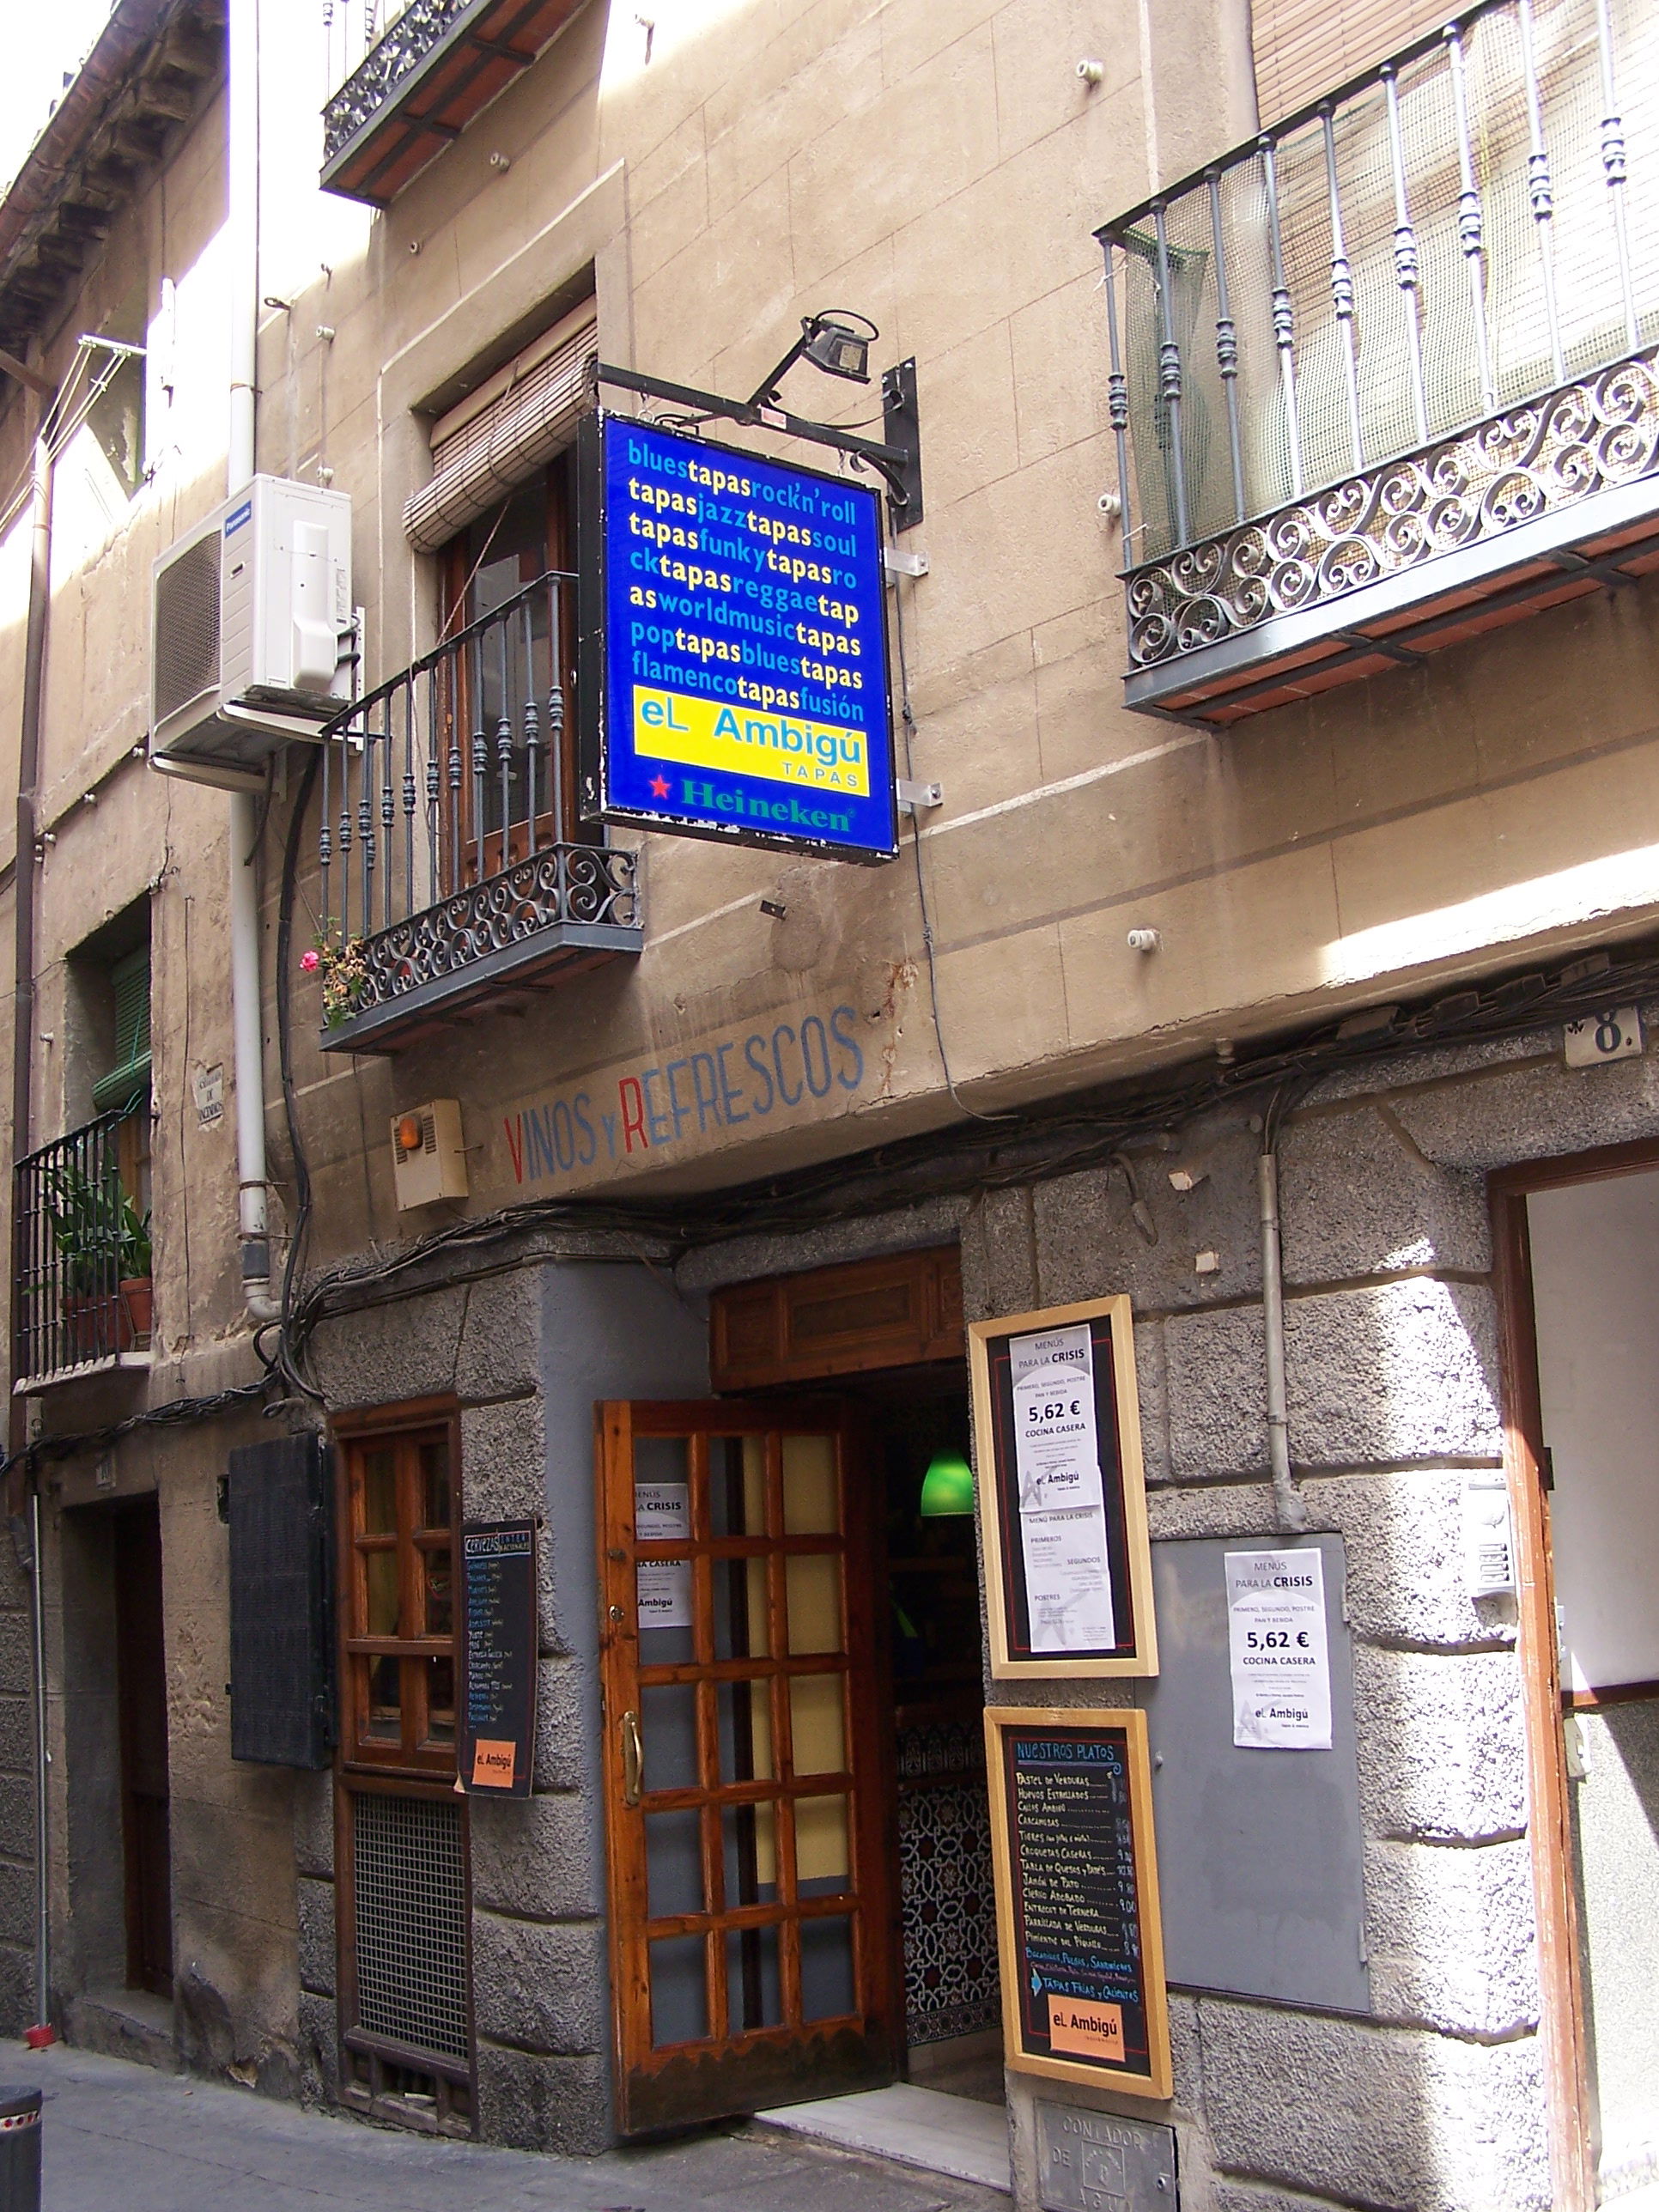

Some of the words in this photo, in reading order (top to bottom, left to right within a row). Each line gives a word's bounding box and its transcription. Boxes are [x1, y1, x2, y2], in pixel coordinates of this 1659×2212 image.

[714, 708, 860, 767] Ambigú
[782, 762, 857, 787] TAPAS
[681, 779, 853, 833] Heineken
[504, 1092, 597, 1184] VINOS
[617, 1006, 865, 1153] REFRESCOS
[1035, 1337, 1065, 1351] MENÚS
[1018, 1358, 1039, 1369] PARA
[1040, 1357, 1050, 1365] LA
[1051, 1348, 1085, 1363] CRISIS
[1029, 1403, 1065, 1424] 5,62
[1070, 1400, 1081, 1416] €
[1025, 1427, 1054, 1438] COCINA
[1055, 1423, 1086, 1434] CASERA
[1048, 1471, 1079, 1484] Ambigú
[647, 1501, 682, 1511] CRISIS
[1075, 1511, 1093, 1520] CRISIS
[1030, 1534, 1062, 1544] PRIMEROS
[1067, 1556, 1101, 1565] SEGUNDOS
[1254, 1560, 1287, 1571] MENÚS
[1236, 1579, 1260, 1589] PARA
[1261, 1578, 1272, 1588] LA
[1273, 1575, 1313, 1588] CRISIS
[638, 1598, 673, 1608] Ambigú
[1034, 1594, 1060, 1602] POSTRES
[1247, 1631, 1291, 1651] 5,62
[1296, 1631, 1310, 1649] €
[1243, 1656, 1278, 1666] COCINA
[1279, 1656, 1316, 1666] CASERA
[1269, 1707, 1309, 1722] Ambigú
[1077, 1745, 1115, 1760] PLATOS
[1042, 1977, 1070, 1992] TAPAS
[1071, 2014, 1117, 2038] Ambigú
[1062, 2116, 1145, 2150] CONTADOR
[1052, 2146, 1072, 2168] DE
